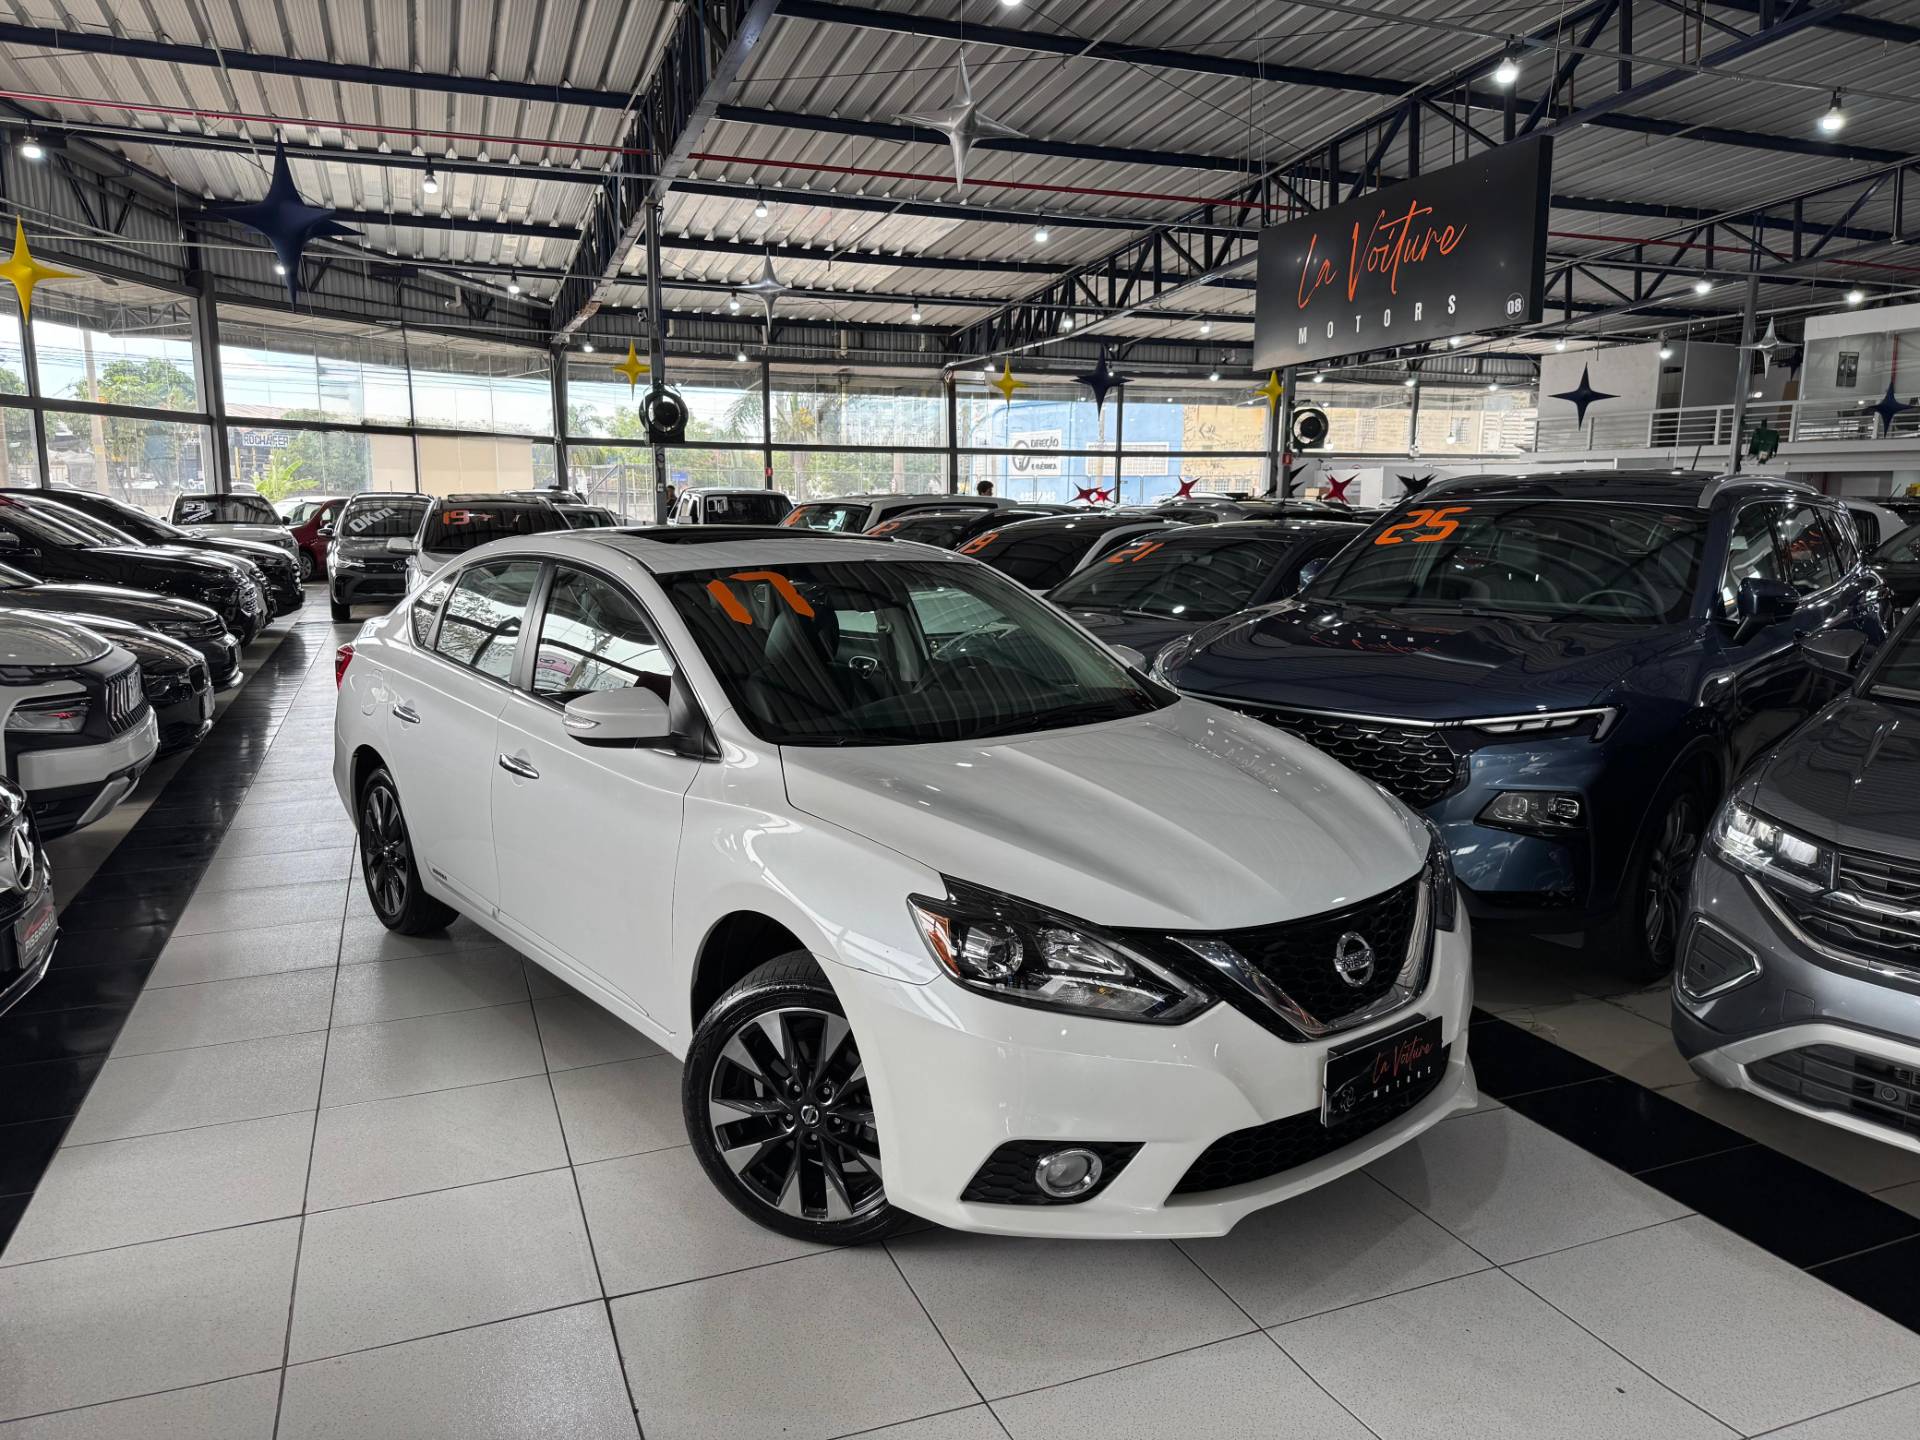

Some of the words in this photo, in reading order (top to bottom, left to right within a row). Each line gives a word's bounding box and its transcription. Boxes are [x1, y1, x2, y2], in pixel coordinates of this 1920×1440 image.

[1298, 233, 1339, 309] La
[1347, 200, 1468, 302] Voiture
[1298, 295, 1457, 345] MOTORS
[1507, 297, 1523, 316] 08
[443, 510, 470, 526] 19
[1374, 506, 1473, 545] 25
[1105, 541, 1165, 563] 21
[706, 571, 816, 625] 17
